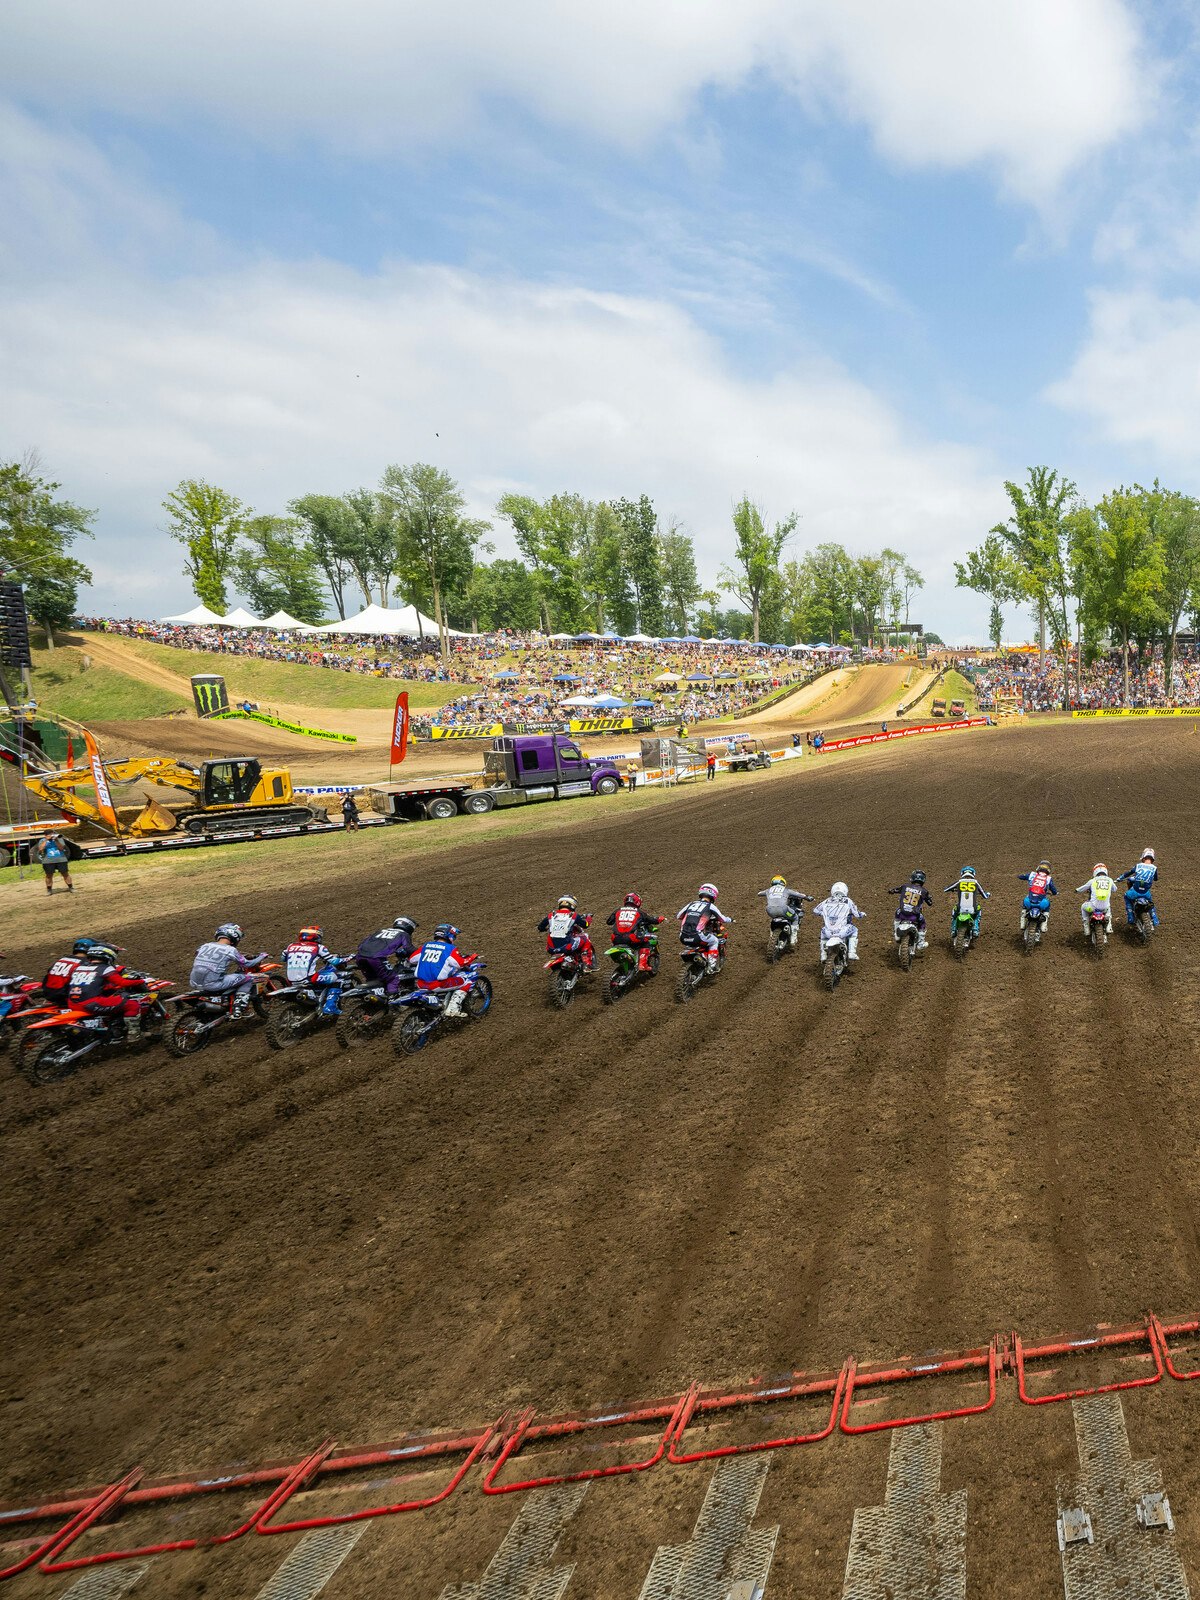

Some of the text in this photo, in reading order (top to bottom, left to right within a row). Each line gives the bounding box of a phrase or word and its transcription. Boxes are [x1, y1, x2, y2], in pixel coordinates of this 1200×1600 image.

[277, 720, 305, 734] Kawasaki
[308, 729, 339, 740] Kawasaki
[394, 706, 404, 748] TUCKER
[579, 719, 625, 730] THOR
[439, 725, 494, 738] THOR
[91, 754, 112, 807] TUCKER
[317, 786, 360, 794] PARTS
[960, 881, 976, 892] 55
[688, 901, 709, 912] 41
[618, 910, 636, 921] 805
[374, 929, 399, 939] 702
[199, 945, 226, 961] 245
[422, 949, 442, 963] 703
[50, 961, 73, 977] 504
